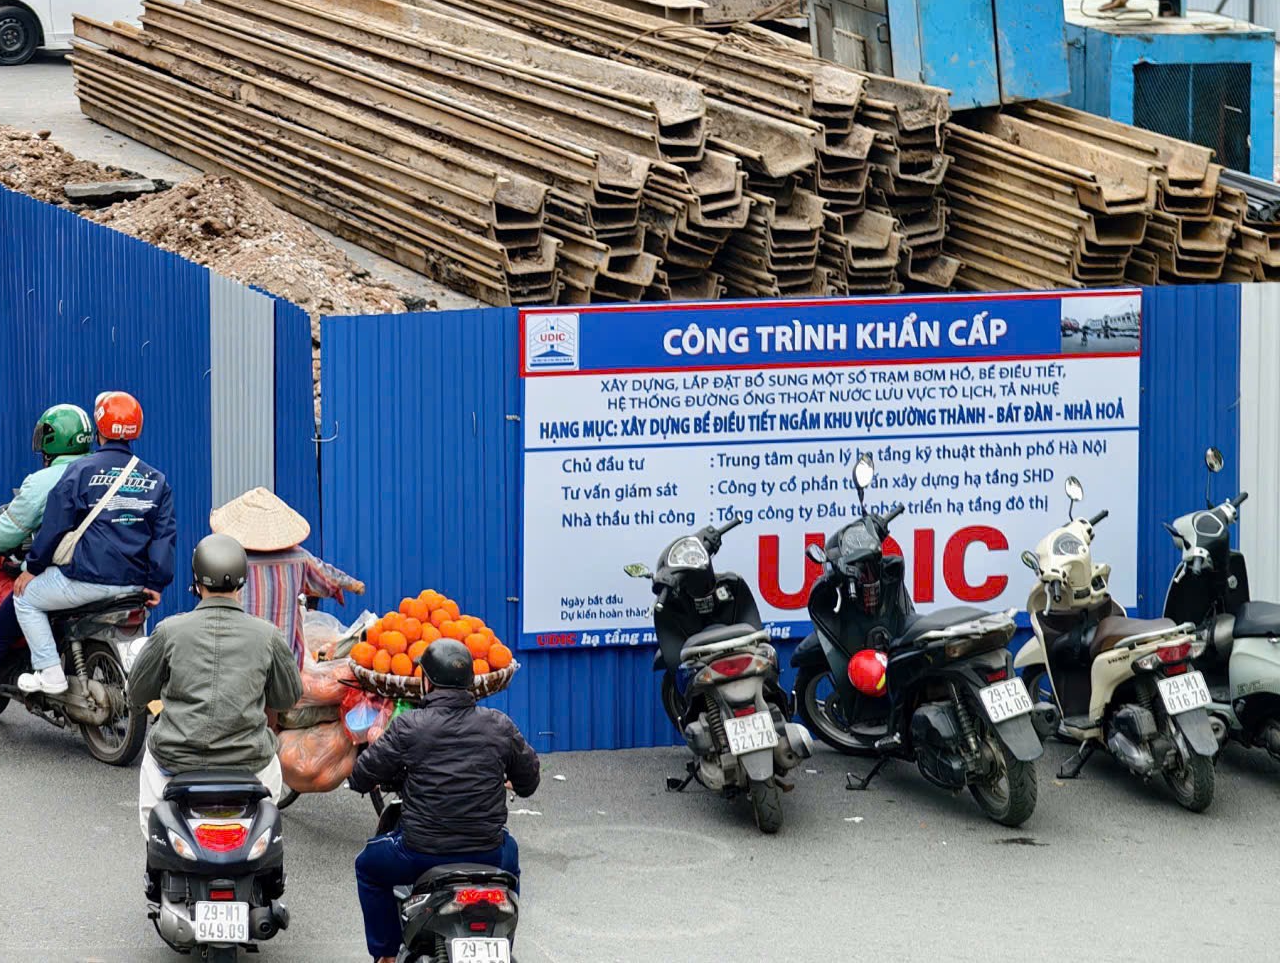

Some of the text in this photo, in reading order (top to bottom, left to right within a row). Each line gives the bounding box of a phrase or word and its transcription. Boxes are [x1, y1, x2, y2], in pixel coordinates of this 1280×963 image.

[540, 333, 566, 342] UDIC
[663, 311, 1008, 356] CÔNG TRÌNH KHẨN CẤP
[601, 379, 628, 393] XÂY
[632, 377, 679, 394] DỰNG,
[683, 375, 709, 390] LẮP
[713, 376, 741, 391] ĐẶT
[769, 374, 808, 387] SUNG
[813, 373, 845, 388] MỘT
[848, 369, 867, 385] SỐ
[870, 370, 910, 385] TRẠM
[914, 369, 946, 382] BƠM
[999, 363, 1032, 379] ĐIỀU
[1035, 362, 1066, 379] TIẾT,
[607, 396, 626, 412] HỆ
[630, 394, 680, 409] THỐNG
[685, 392, 739, 408] ĐƯỜNG
[743, 390, 775, 406] ỐNG
[778, 389, 825, 405] THOÁT
[829, 386, 872, 402] NƯỚC
[875, 386, 903, 401] LƯU
[906, 386, 936, 401] VỰC
[939, 384, 958, 398] TÔ
[962, 385, 996, 401] LỊCH,
[1021, 381, 1060, 397] NHUỆ
[539, 421, 580, 444] HẠNG
[583, 419, 618, 442] MỤC:
[621, 415, 649, 437] XÂY
[650, 415, 690, 440] DỰNG
[694, 411, 711, 434] BỂ
[713, 410, 746, 433] ĐIỀU
[748, 409, 776, 432] TIẾT
[779, 408, 821, 431] NGẦM
[823, 411, 852, 429] KHU
[855, 408, 883, 433] VỰC
[886, 406, 936, 427] ĐƯỜNG
[939, 404, 986, 424] THÀNH
[997, 402, 1020, 423] BÁT
[1023, 402, 1054, 422] ĐÀN
[1064, 400, 1092, 420] NHÀ
[562, 439, 1107, 473] Chủ đầu tư Trung tâm quản lý tầng kỹ thuật thành phố Hà Nội
[561, 467, 1054, 502] Tư vấn giám sát Công ty cổ phần xây dựng hạ tầng SHD
[562, 512, 592, 528] Nhà
[596, 510, 630, 526] thầu
[634, 509, 654, 524] thi
[658, 509, 696, 526] công
[717, 505, 753, 524] Tổng
[757, 505, 794, 523] công
[798, 506, 813, 520] ty
[817, 502, 846, 518] Đầu
[908, 496, 942, 514] triển
[946, 499, 964, 515] hạ
[968, 495, 1002, 514] tầng
[1005, 495, 1025, 510] đô
[1029, 495, 1048, 512] thị
[759, 524, 1009, 611] UIC
[561, 594, 624, 609] Ngày bắt đầu
[560, 610, 575, 622] Dự
[577, 609, 597, 620] kiến
[599, 608, 623, 619] hoàn
[536, 632, 578, 646] UDIC
[581, 632, 600, 647] hạ
[604, 628, 639, 646] tầng
[988, 682, 1021, 703] 29-E2
[1168, 689, 1208, 711] 816.78
[989, 695, 1031, 718] 314.06
[732, 716, 767, 736] 29-C1
[732, 731, 774, 752] 321.78
[199, 922, 245, 940] 949.09
[462, 942, 500, 958] 29-T1
